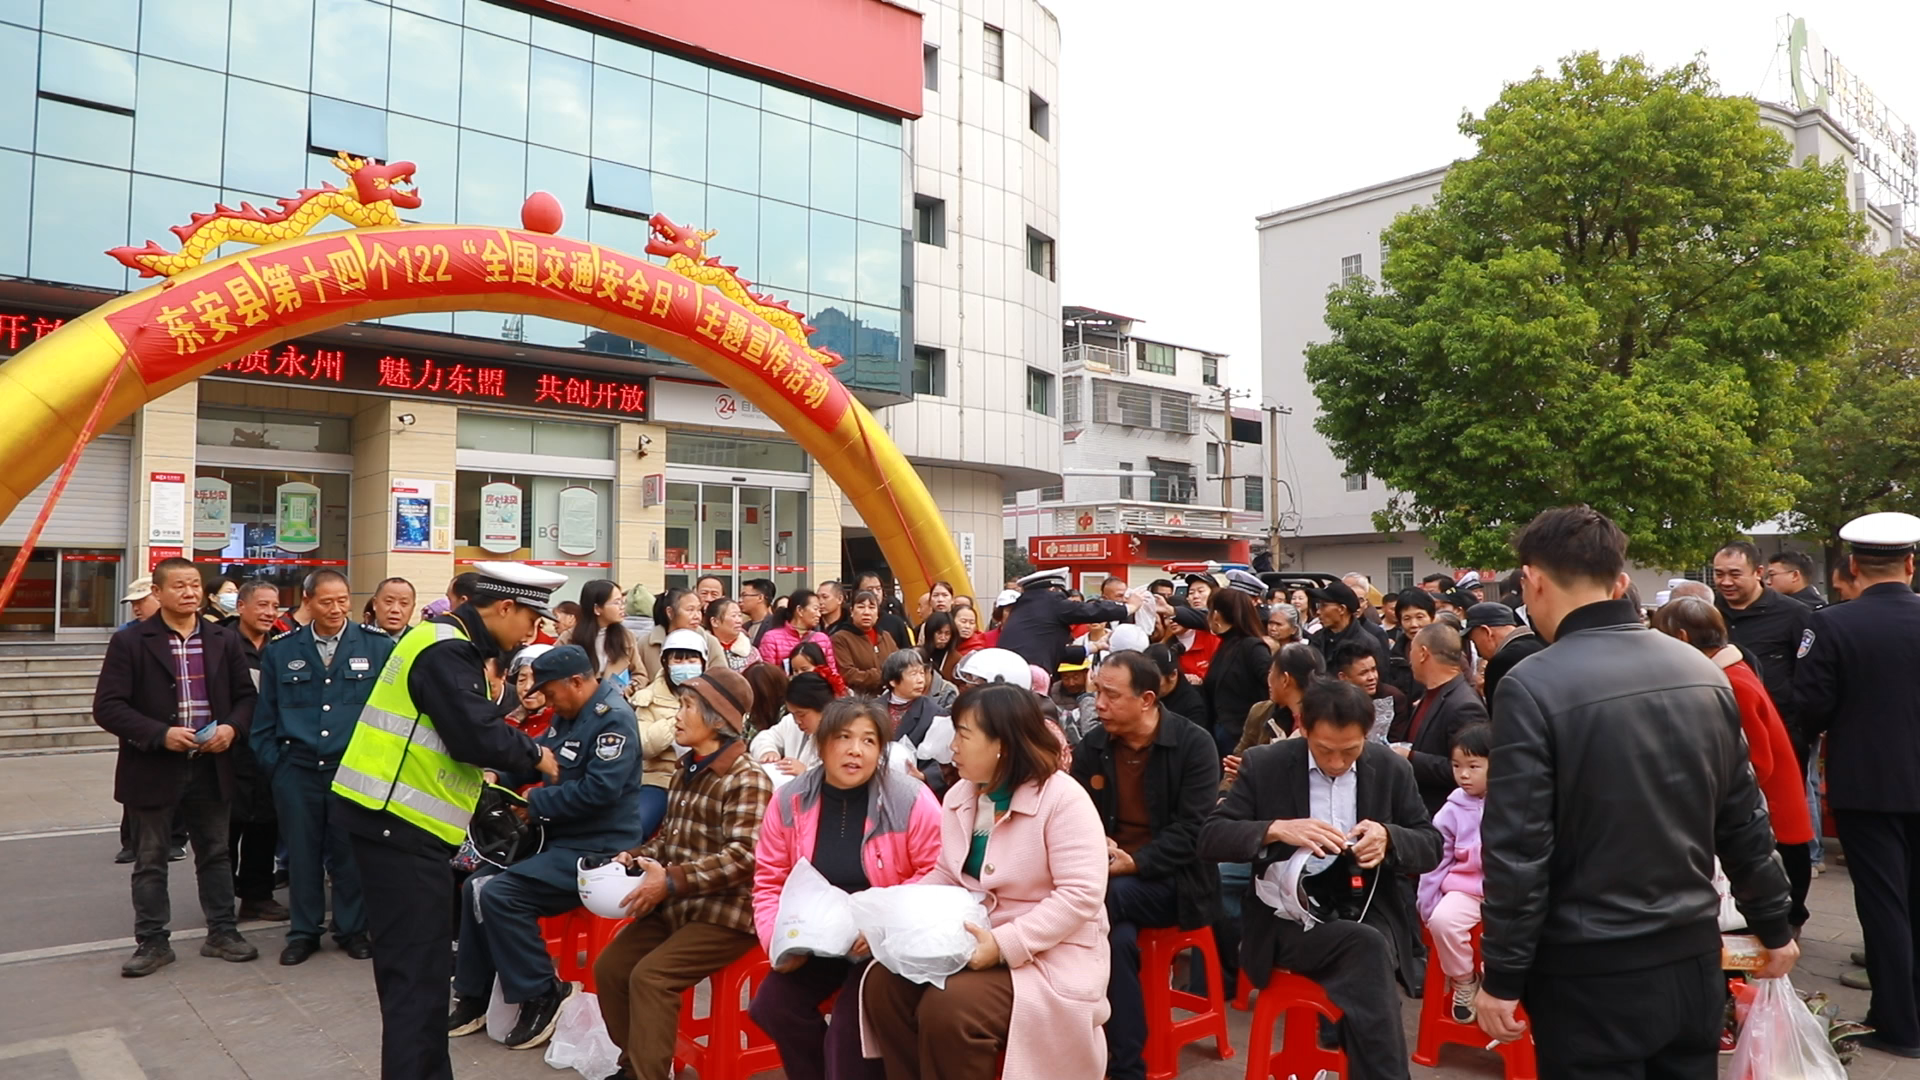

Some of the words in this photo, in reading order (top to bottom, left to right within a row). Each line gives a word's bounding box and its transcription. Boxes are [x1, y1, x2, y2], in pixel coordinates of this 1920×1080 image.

[218, 344, 345, 382] 质永州
[379, 354, 506, 397] 魅力东盟
[535, 373, 645, 413] 共创开放
[718, 397, 737, 415] 24
